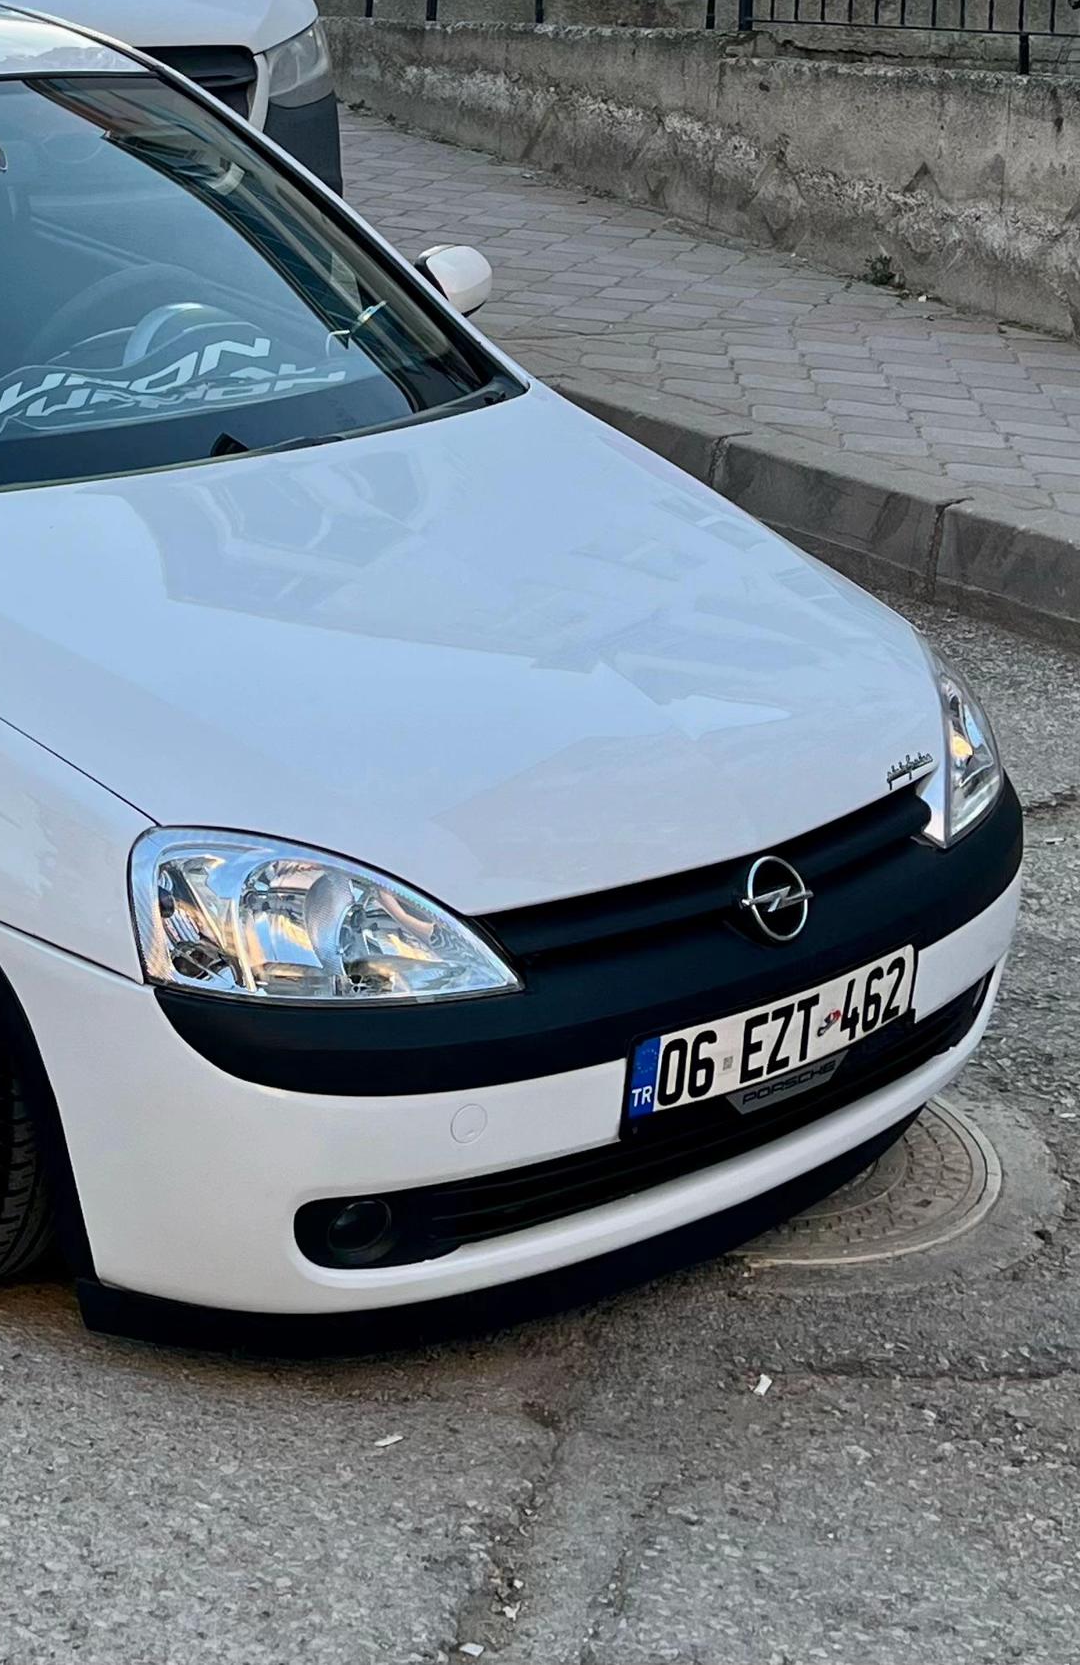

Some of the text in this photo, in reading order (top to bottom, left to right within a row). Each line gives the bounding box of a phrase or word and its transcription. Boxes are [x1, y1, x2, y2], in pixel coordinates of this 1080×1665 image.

[656, 956, 906, 1107] 06 EZT 462
[632, 1088, 653, 1108] TR
[742, 1061, 836, 1104] PORSCHE
